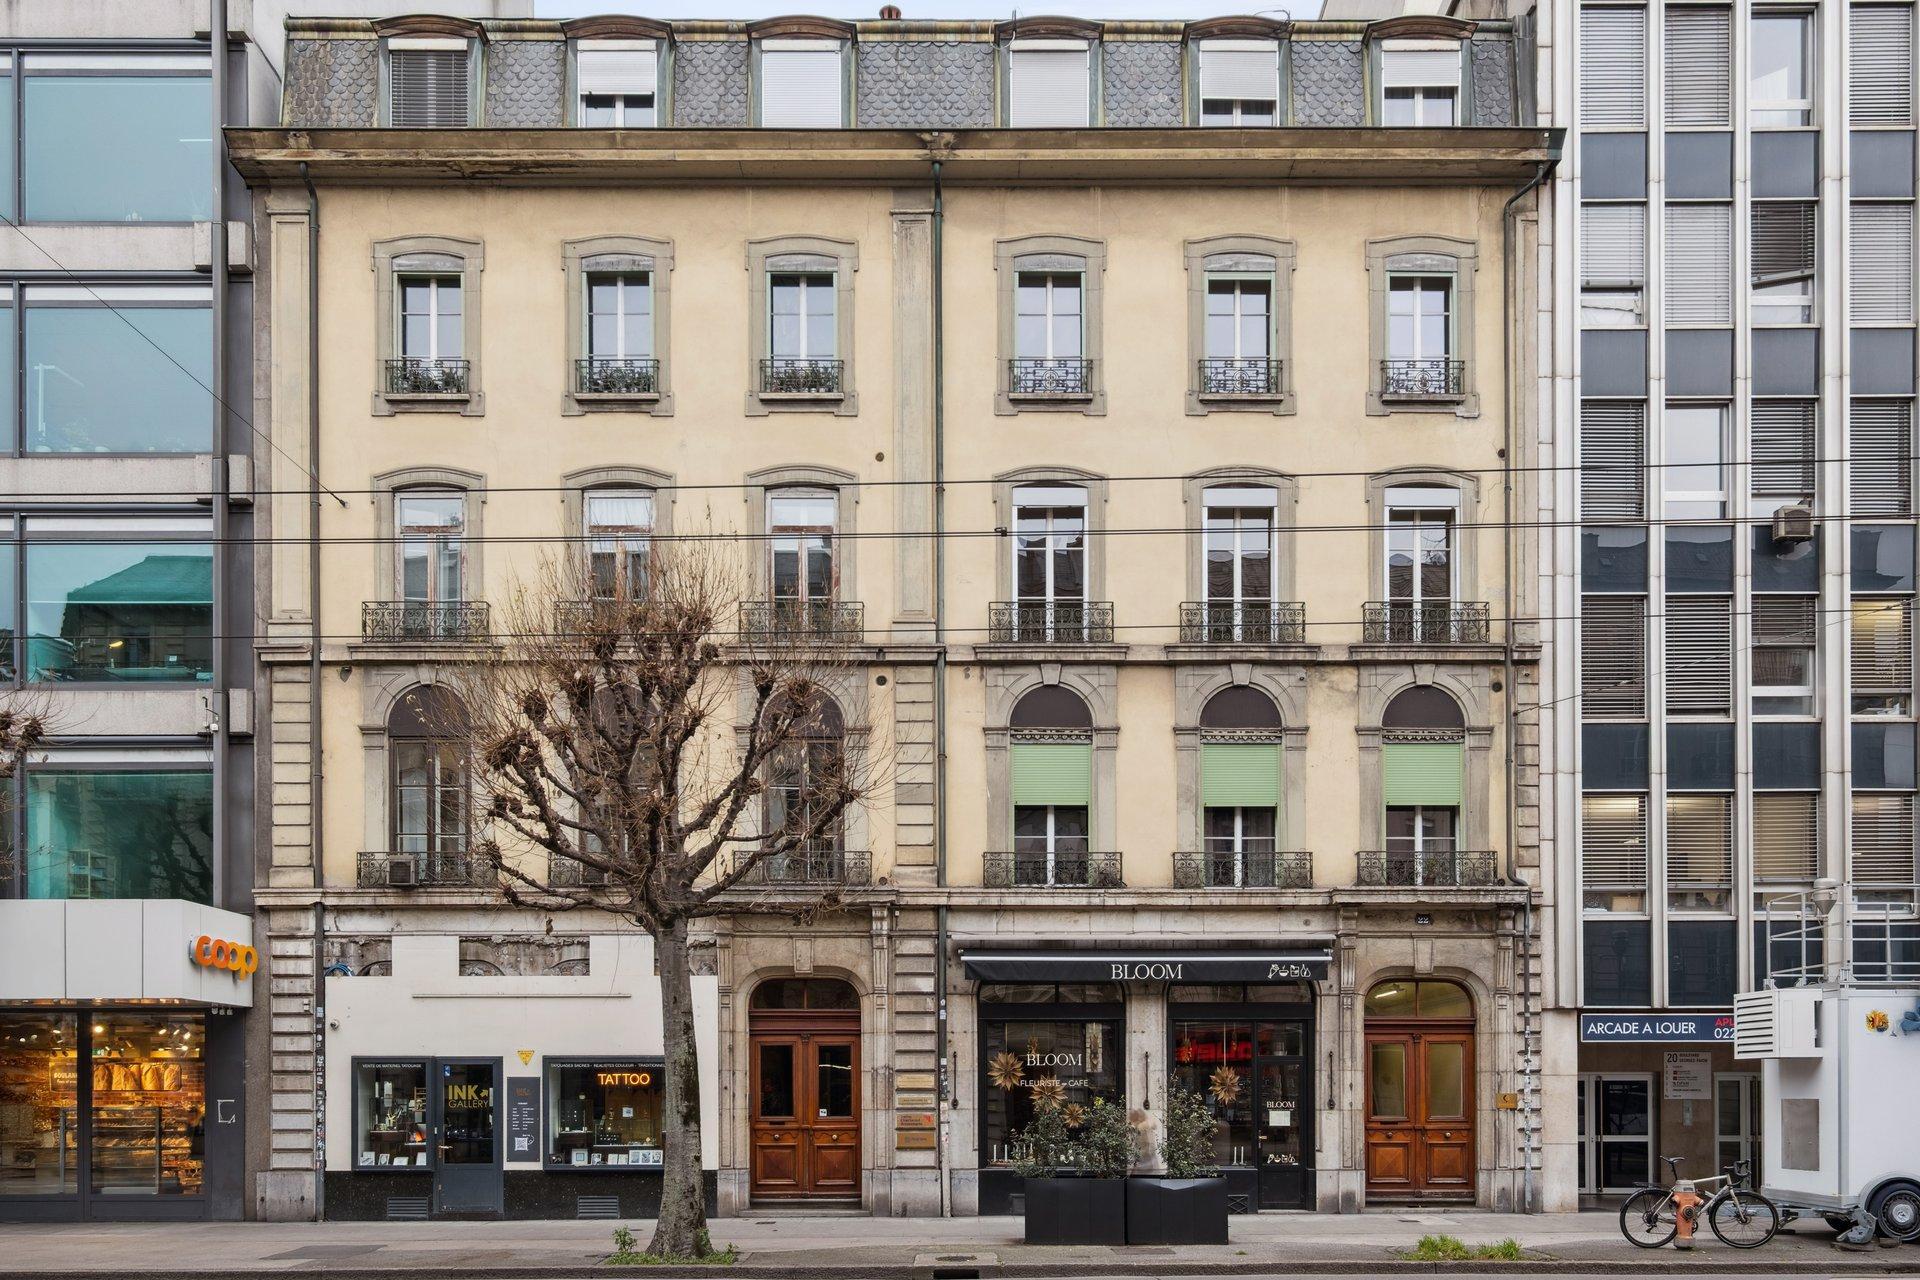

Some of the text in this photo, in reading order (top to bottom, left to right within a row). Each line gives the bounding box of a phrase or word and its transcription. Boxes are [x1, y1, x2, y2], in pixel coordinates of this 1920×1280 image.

[195, 935, 258, 981] coop
[1111, 963, 1183, 980] BLOOM
[1587, 1022, 1696, 1034] ARCADE A LOUER
[1026, 1053, 1082, 1066] BLOOM
[1667, 1053, 1678, 1063] 20
[597, 1073, 650, 1085] TATTOO
[1020, 1079, 1089, 1087] FLEURISTE CAFE
[448, 1085, 479, 1100] INK
[449, 1100, 488, 1108] GALLERY
